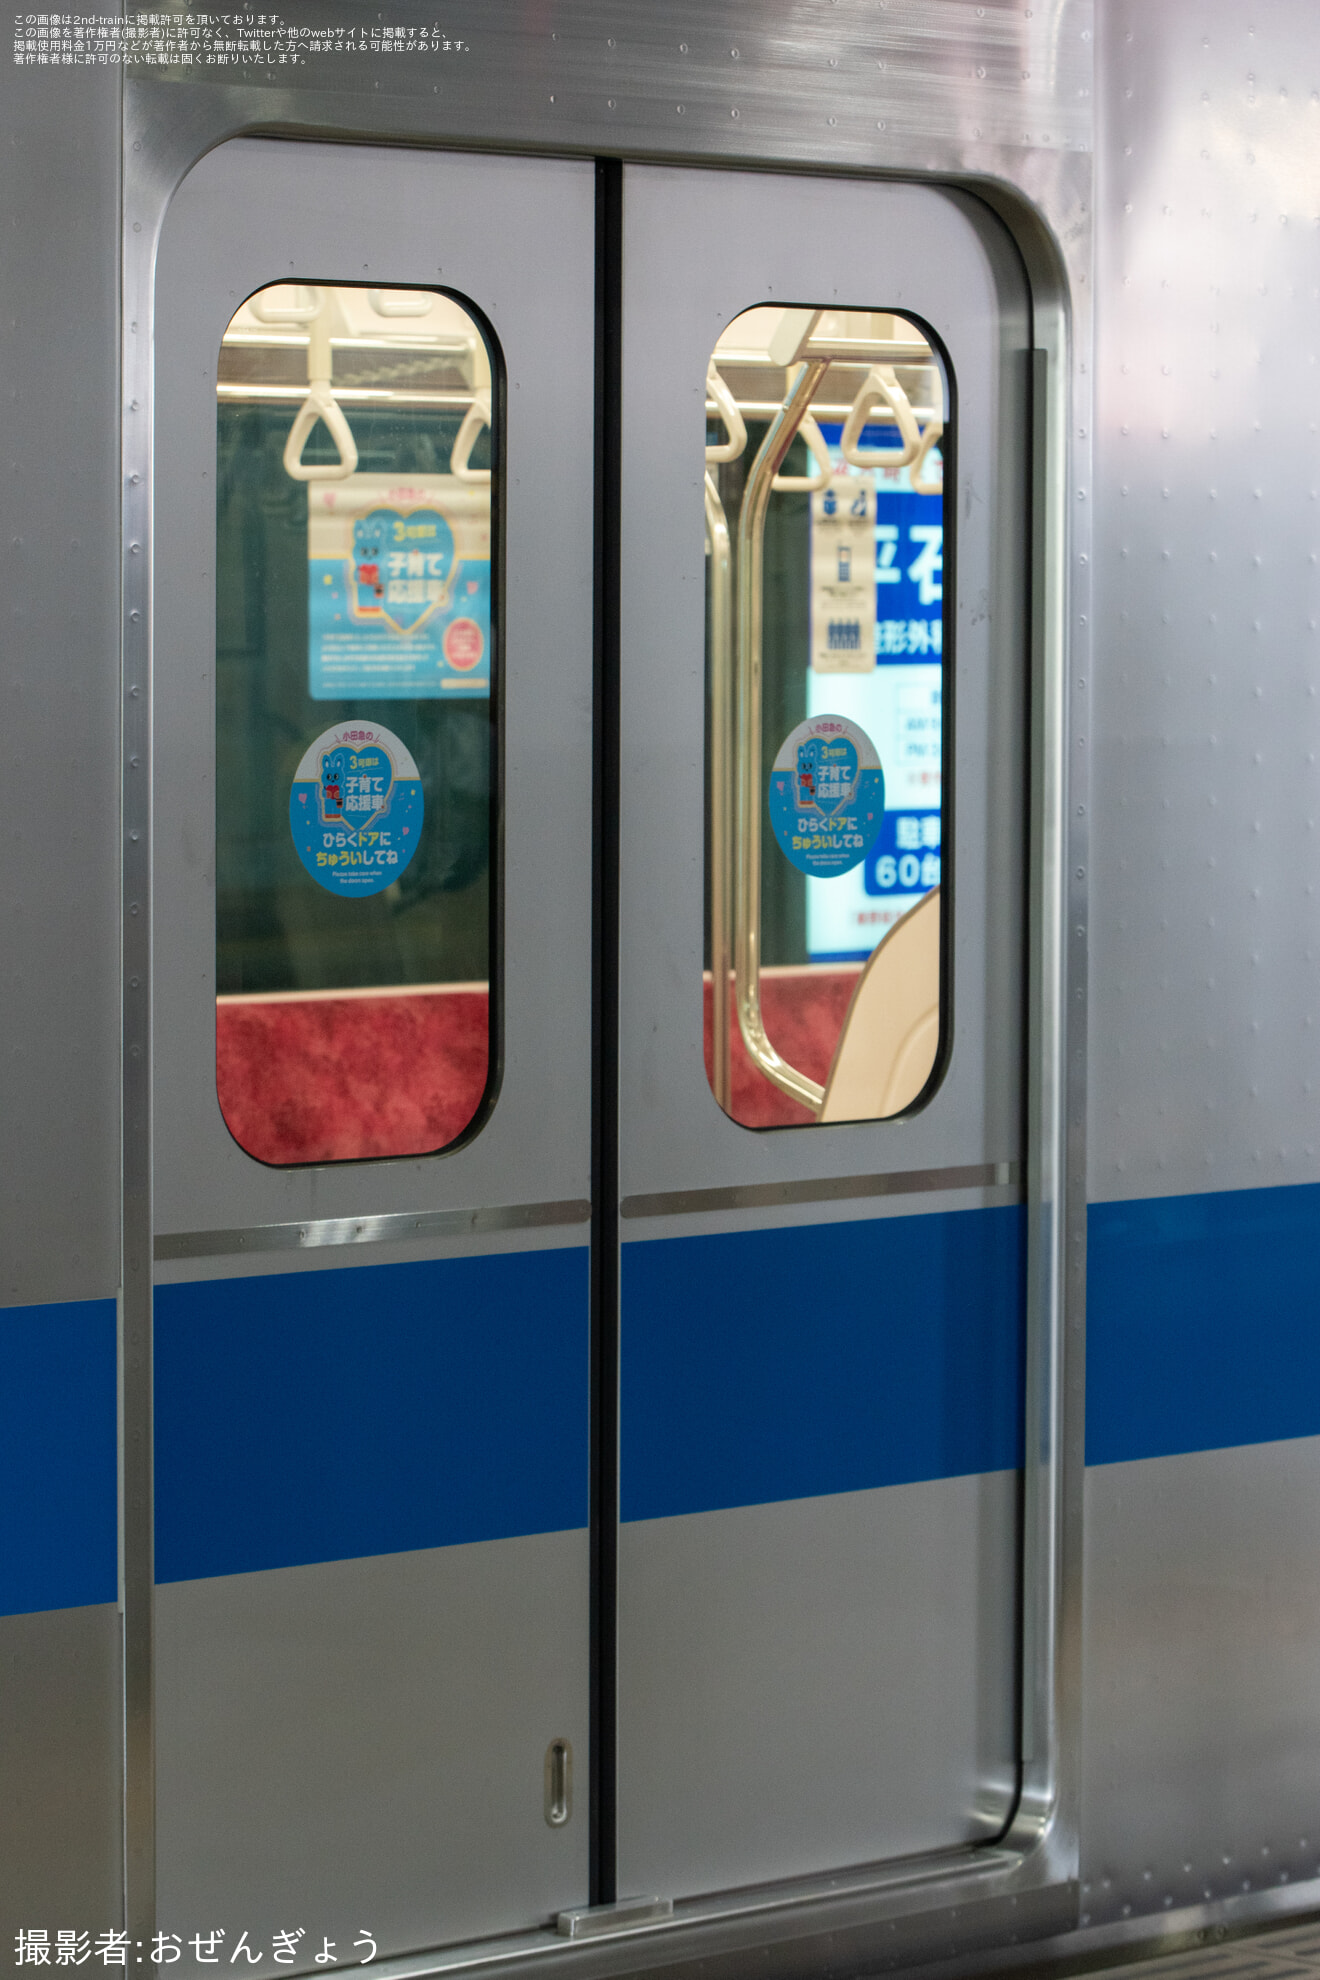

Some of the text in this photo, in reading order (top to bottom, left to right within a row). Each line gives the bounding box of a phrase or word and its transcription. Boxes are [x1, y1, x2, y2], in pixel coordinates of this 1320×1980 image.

[342, 730, 374, 742] 小田急の
[349, 755, 380, 770] 3号車は
[818, 765, 850, 781] 子育て
[345, 775, 384, 793] 子育て
[345, 794, 385, 811] 応援車
[798, 817, 858, 832] ひらくドアに
[323, 831, 391, 848] ひらくドアに
[792, 834, 864, 850] ちゅういしてね
[316, 849, 399, 867] ちゅういしてね
